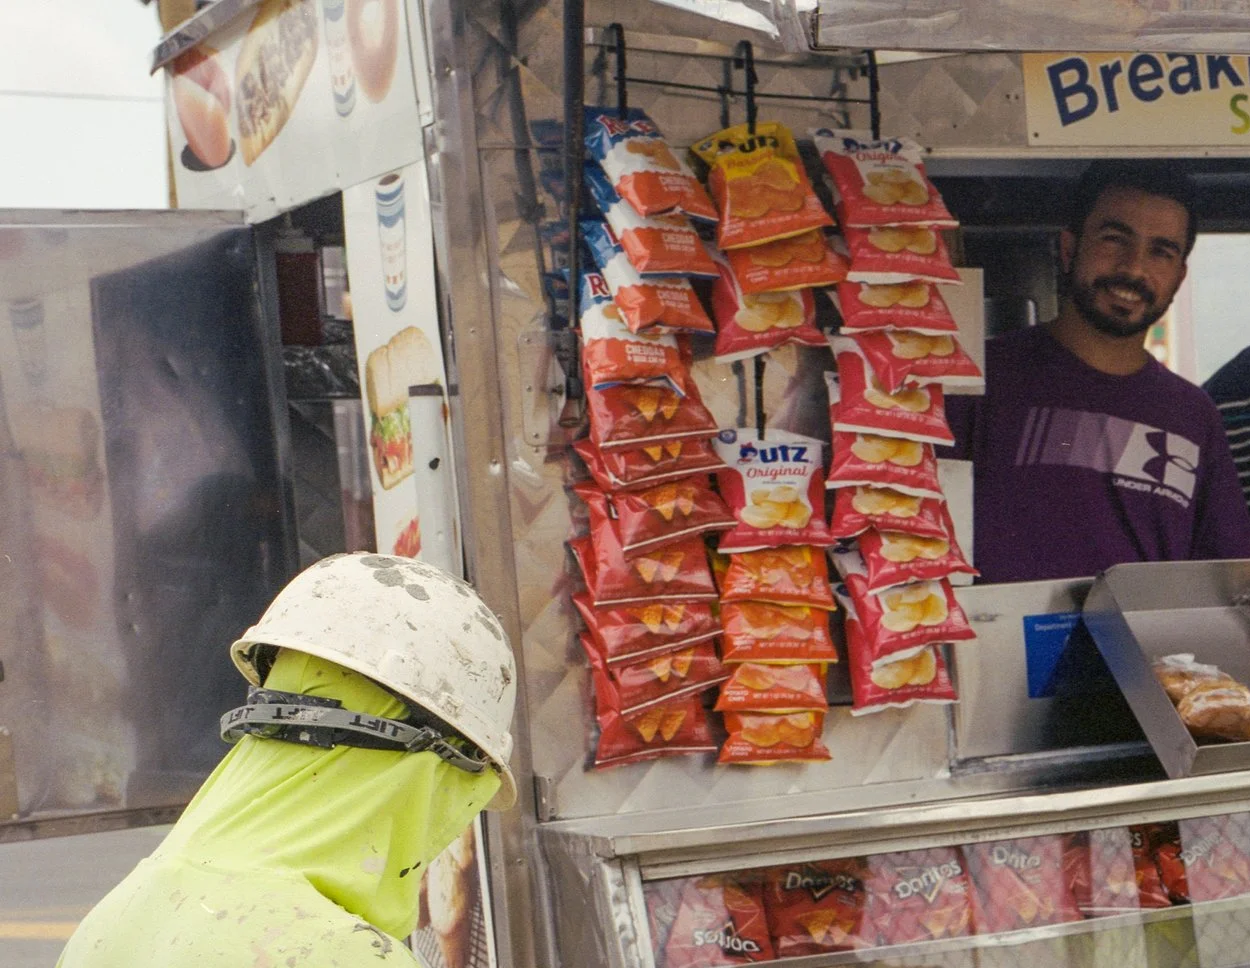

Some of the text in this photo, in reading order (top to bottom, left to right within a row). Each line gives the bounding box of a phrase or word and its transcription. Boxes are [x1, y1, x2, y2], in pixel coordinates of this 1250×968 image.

[746, 466, 808, 480] Original
[1112, 478, 1152, 493] UNDER
[349, 714, 405, 737] LIFT
[785, 872, 857, 892] Doos
